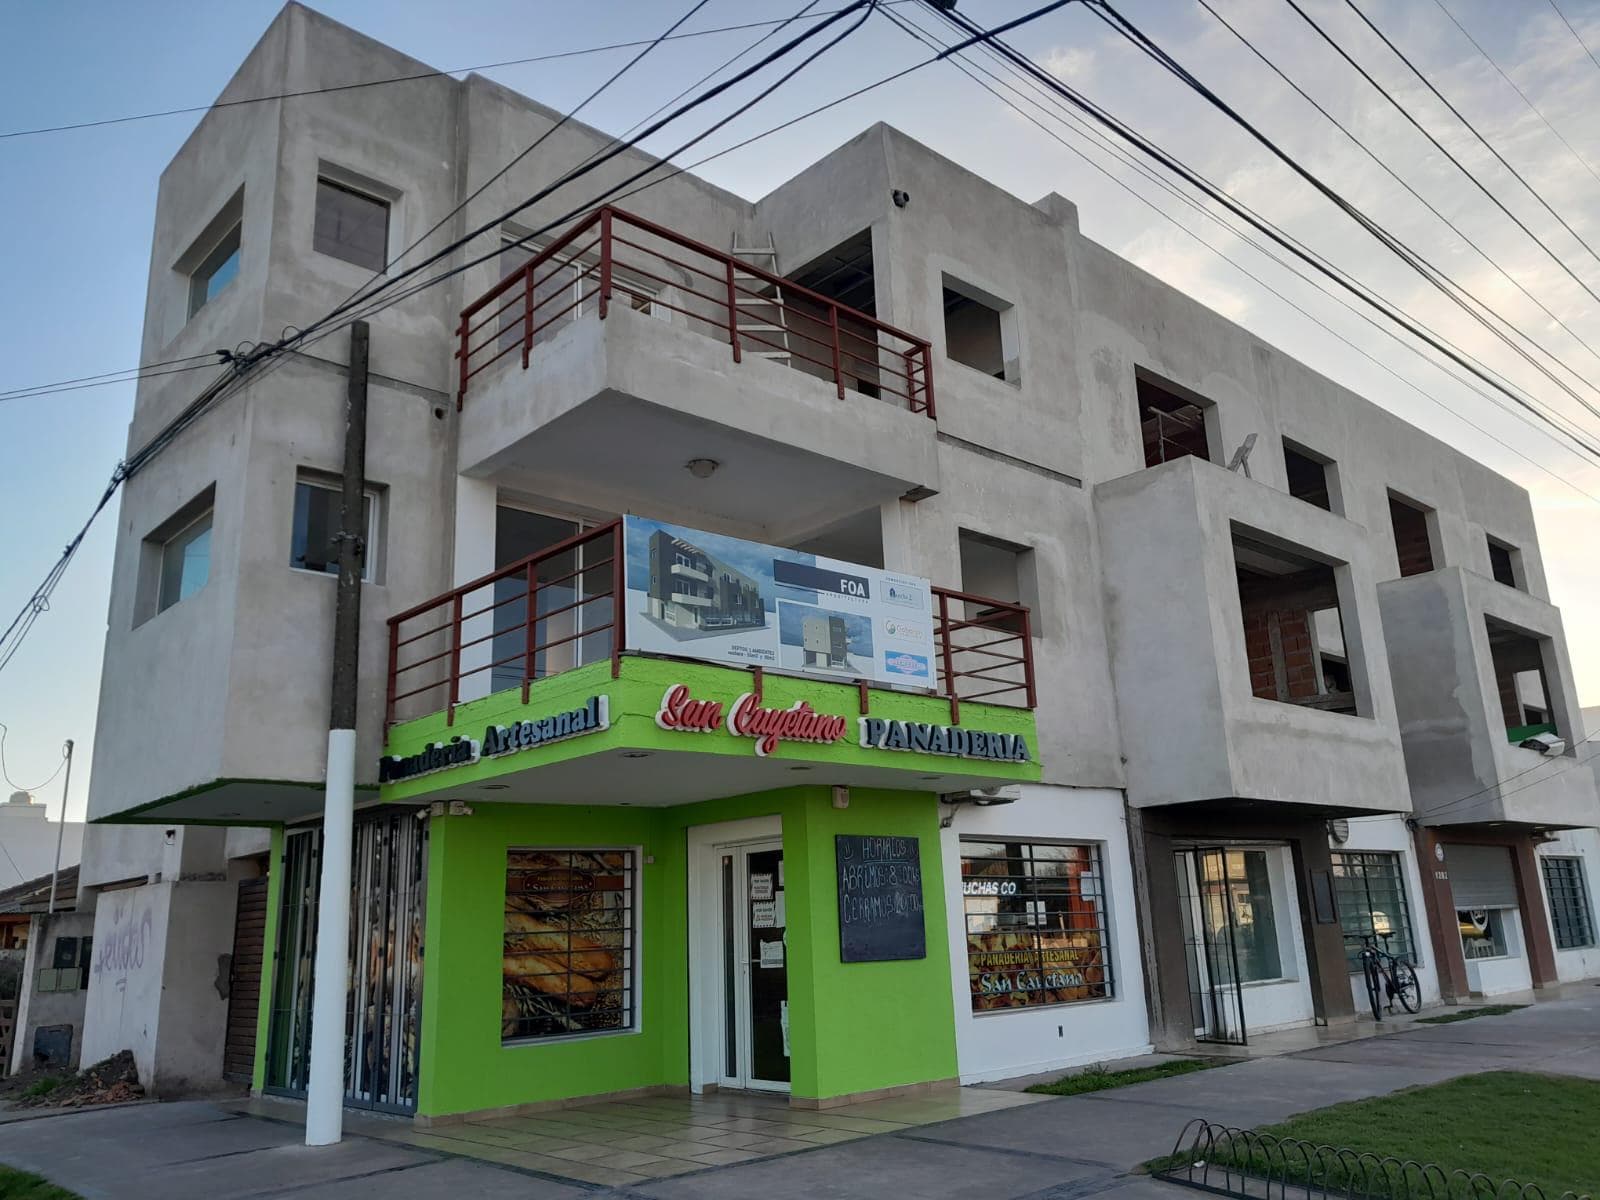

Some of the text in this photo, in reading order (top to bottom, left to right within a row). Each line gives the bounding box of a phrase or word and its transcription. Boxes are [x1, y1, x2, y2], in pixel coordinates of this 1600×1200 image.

[841, 578, 866, 597] FOA
[481, 694, 609, 758] Artesanal
[656, 684, 1031, 763] San Cayetano PANADERIA
[1000, 882, 1017, 895] CO
[980, 951, 1030, 966] PANADERIA
[980, 973, 1012, 994] San
